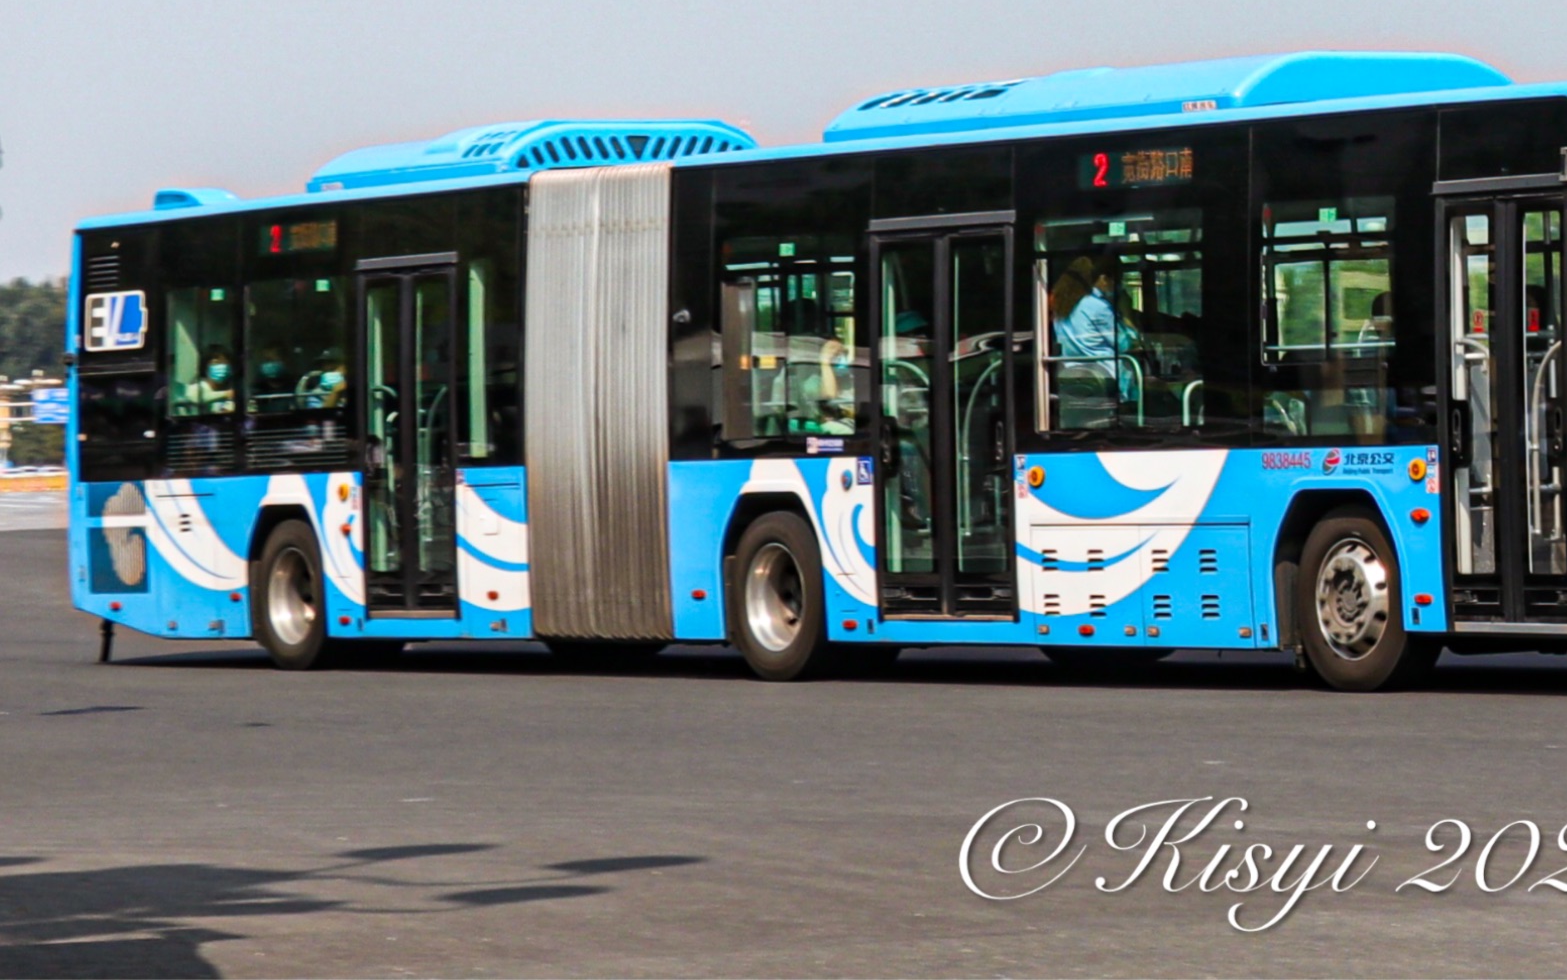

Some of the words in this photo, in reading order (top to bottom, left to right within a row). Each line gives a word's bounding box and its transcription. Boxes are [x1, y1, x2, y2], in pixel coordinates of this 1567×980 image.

[1093, 152, 1109, 188] 2
[1261, 452, 1312, 470] 9838445
[1343, 453, 1395, 466] 北京公交
